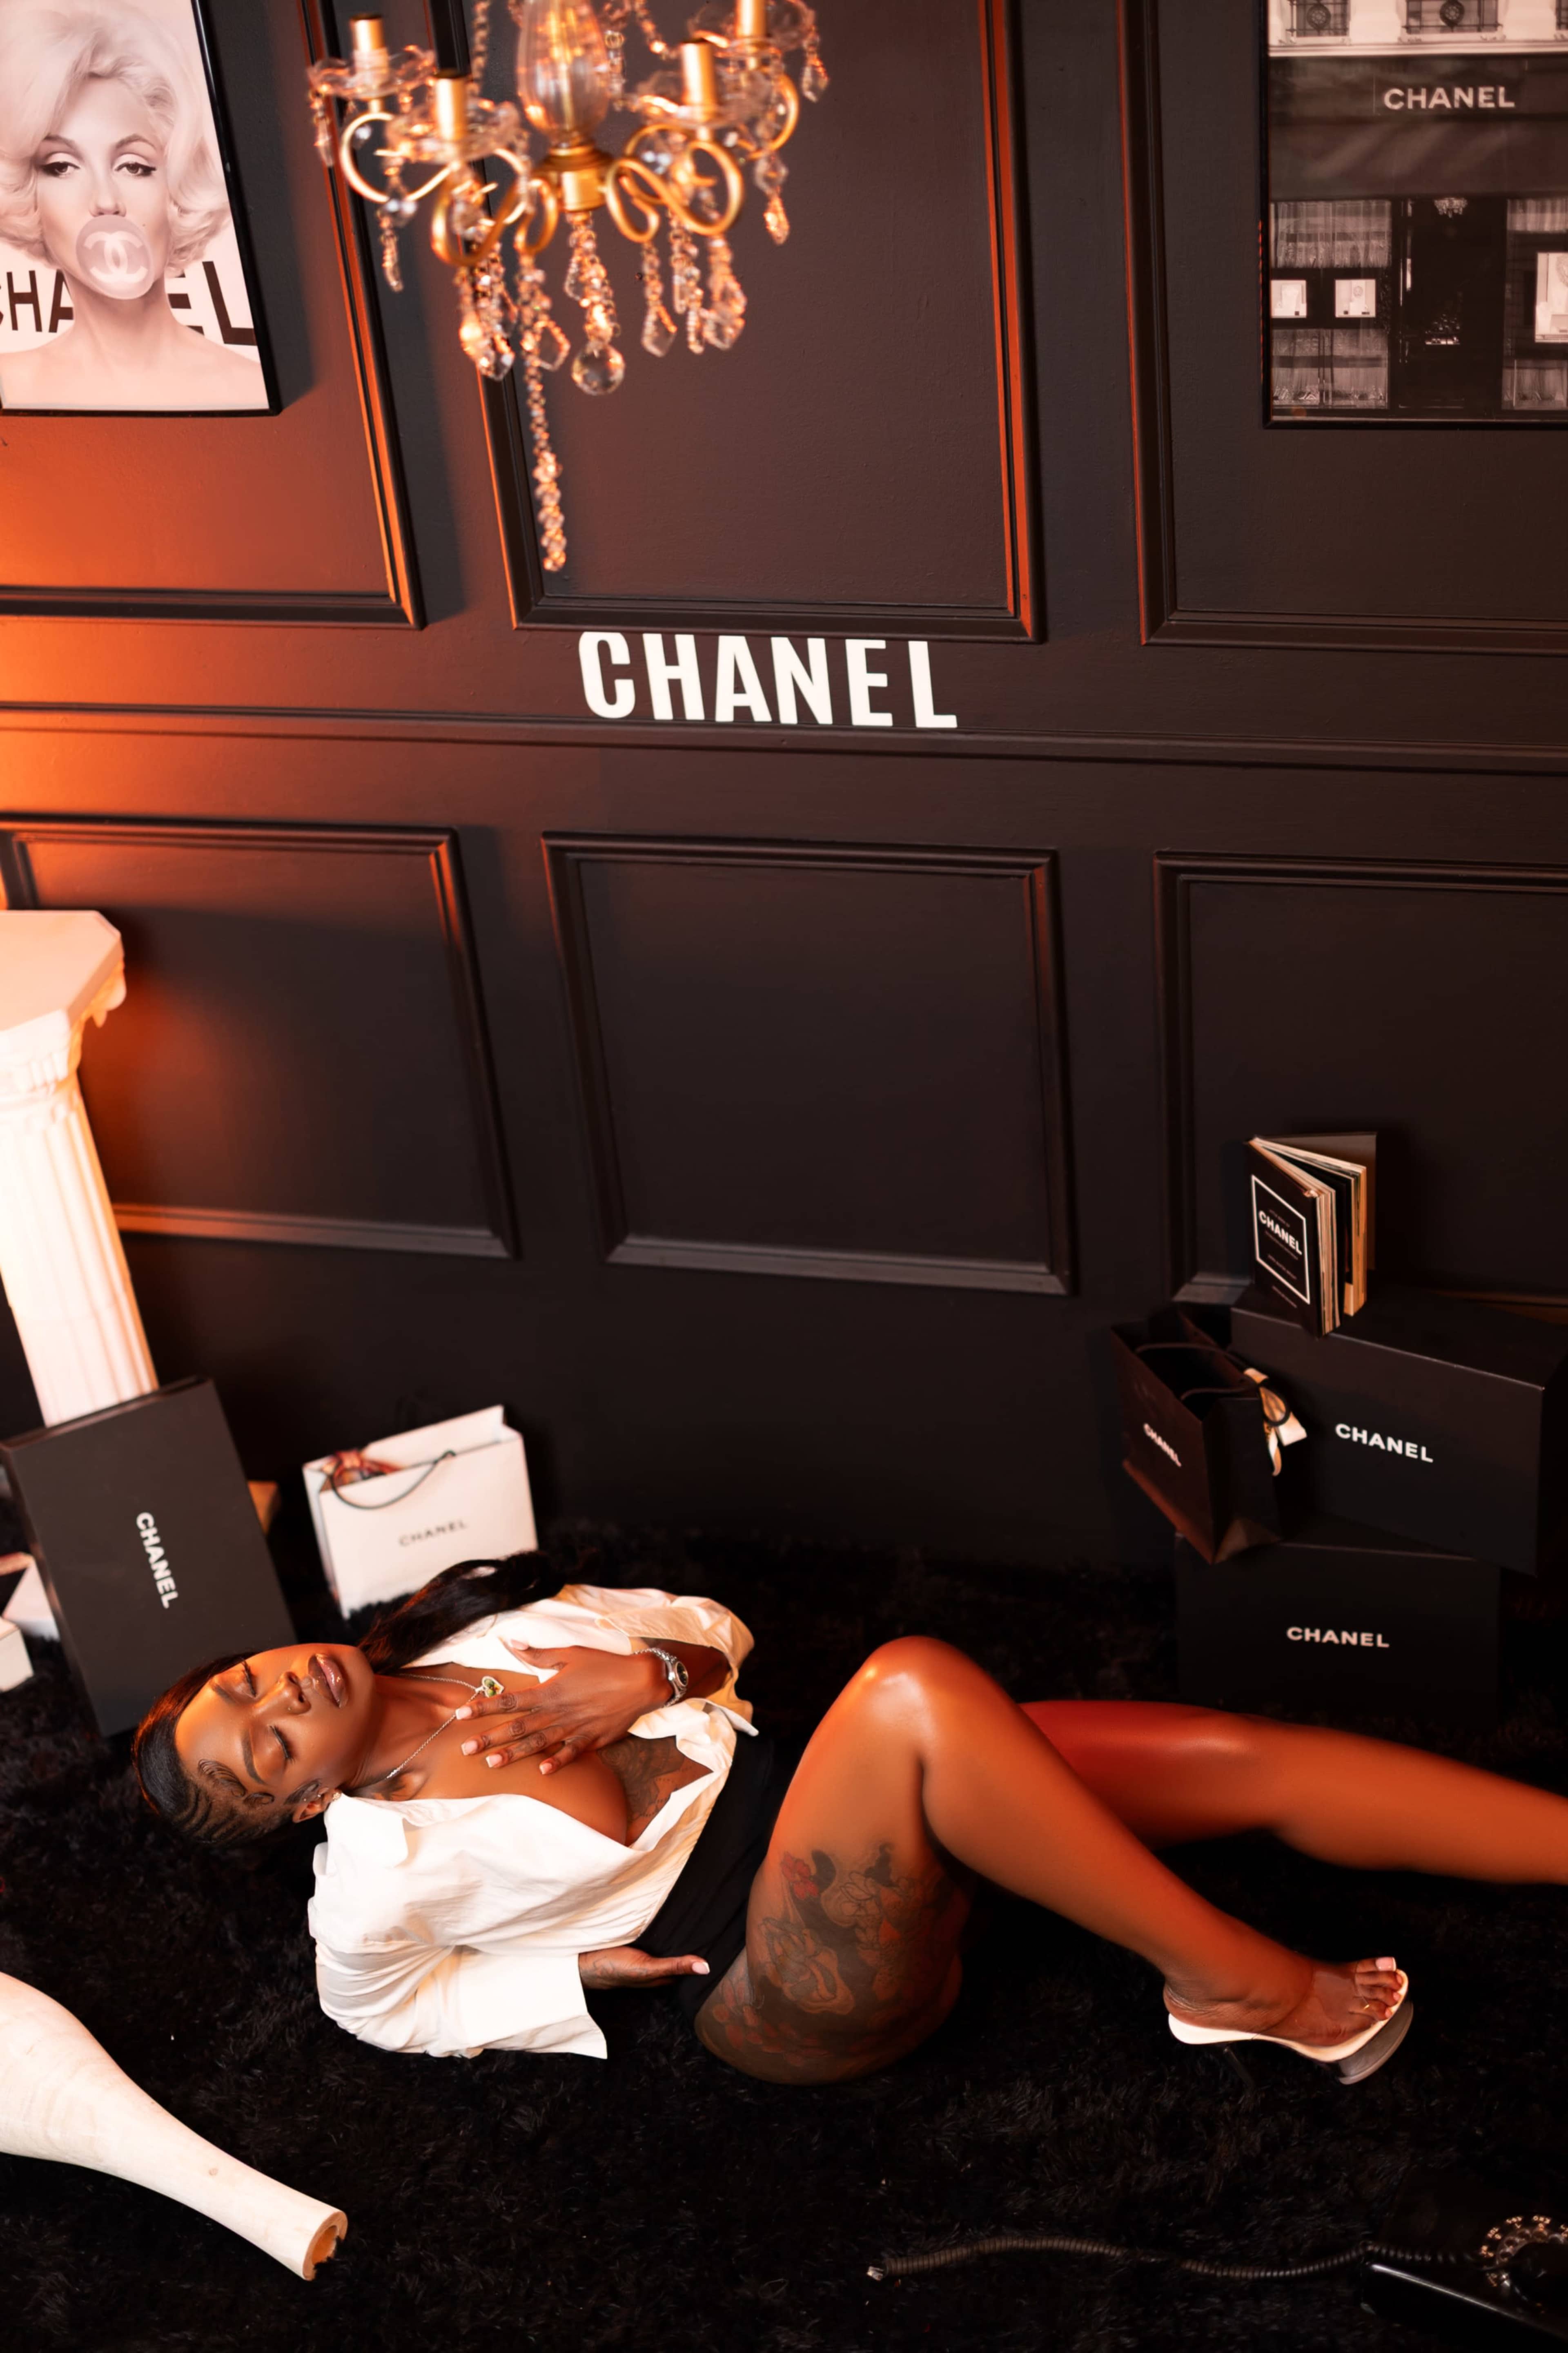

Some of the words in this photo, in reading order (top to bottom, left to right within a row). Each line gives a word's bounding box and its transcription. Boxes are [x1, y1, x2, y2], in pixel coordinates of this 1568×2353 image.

[1383, 87, 1515, 110] CHANEL
[579, 631, 957, 728] CHANEL
[1258, 1210, 1302, 1255] CHANEL
[1335, 1423, 1433, 1463] CHANEL
[399, 1519, 468, 1547] CHANEL
[136, 1512, 178, 1608] CHANEL
[1287, 1627, 1390, 1648] CHANEL
